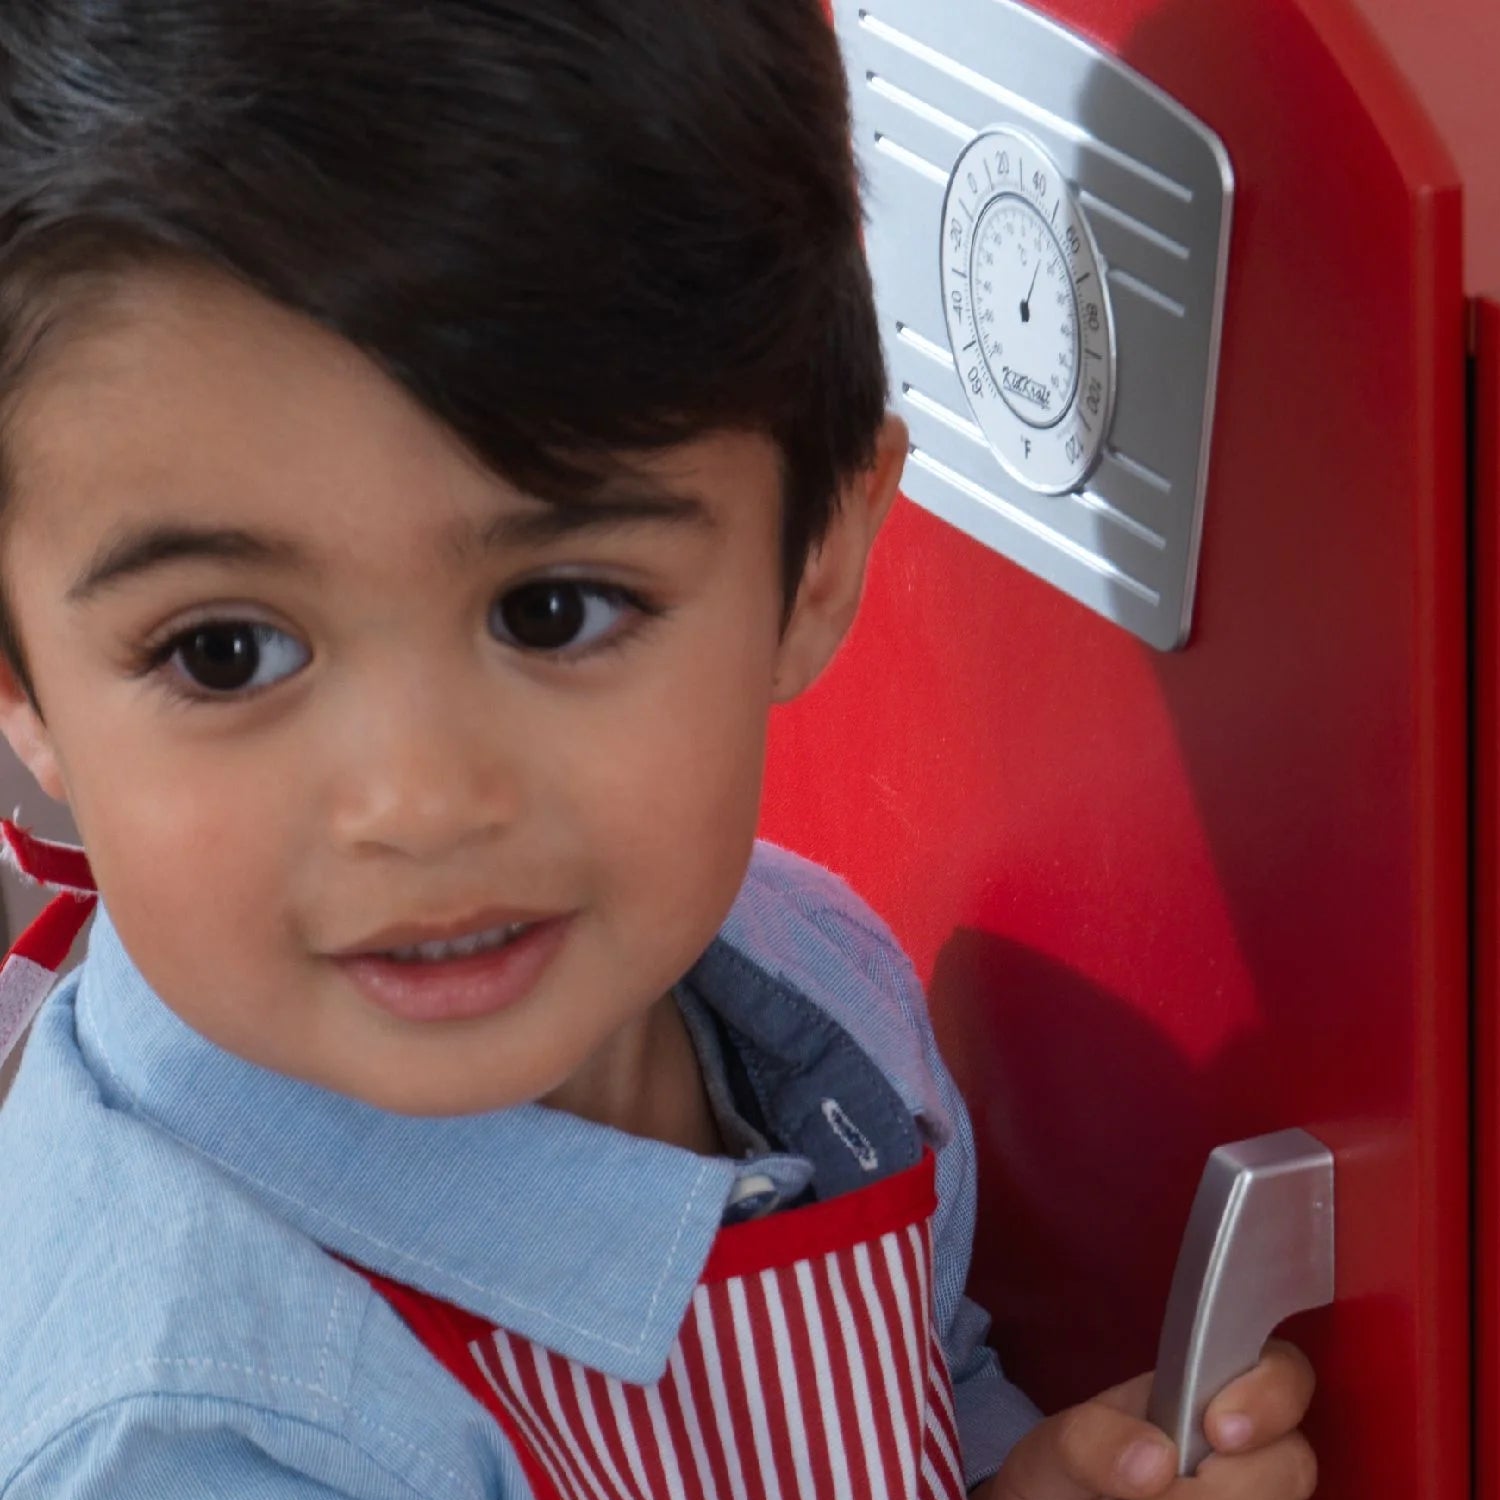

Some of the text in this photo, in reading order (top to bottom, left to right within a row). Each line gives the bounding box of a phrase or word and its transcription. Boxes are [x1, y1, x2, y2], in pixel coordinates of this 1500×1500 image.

[995, 150, 1010, 174] 20
[967, 172, 978, 194] 0
[1032, 171, 1047, 197] 40
[1065, 226, 1080, 254] 60
[1085, 302, 1100, 331] 80
